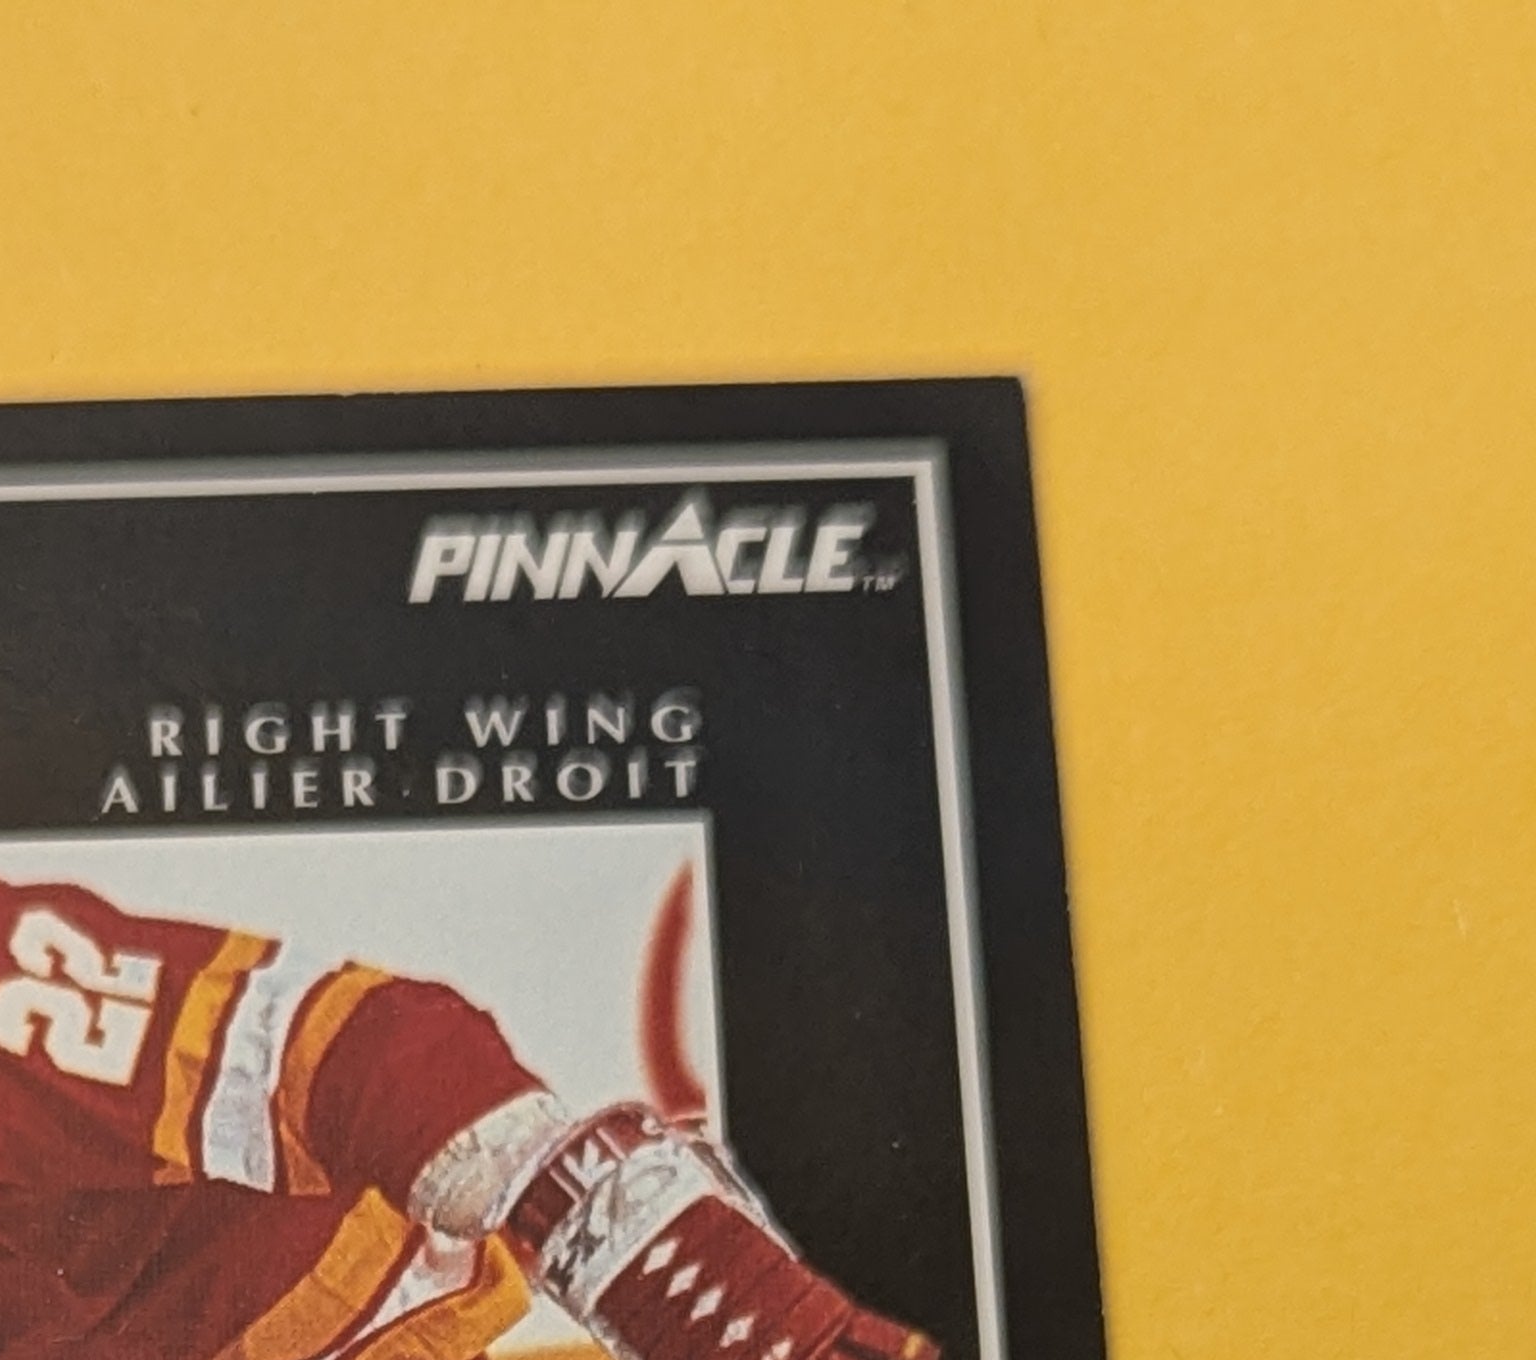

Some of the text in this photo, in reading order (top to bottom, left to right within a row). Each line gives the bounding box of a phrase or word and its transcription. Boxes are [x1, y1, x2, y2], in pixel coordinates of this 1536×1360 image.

[408, 501, 864, 603] PINNACLE
[148, 702, 696, 758] RIGHT WING
[101, 757, 696, 814] AILIER DROIT
